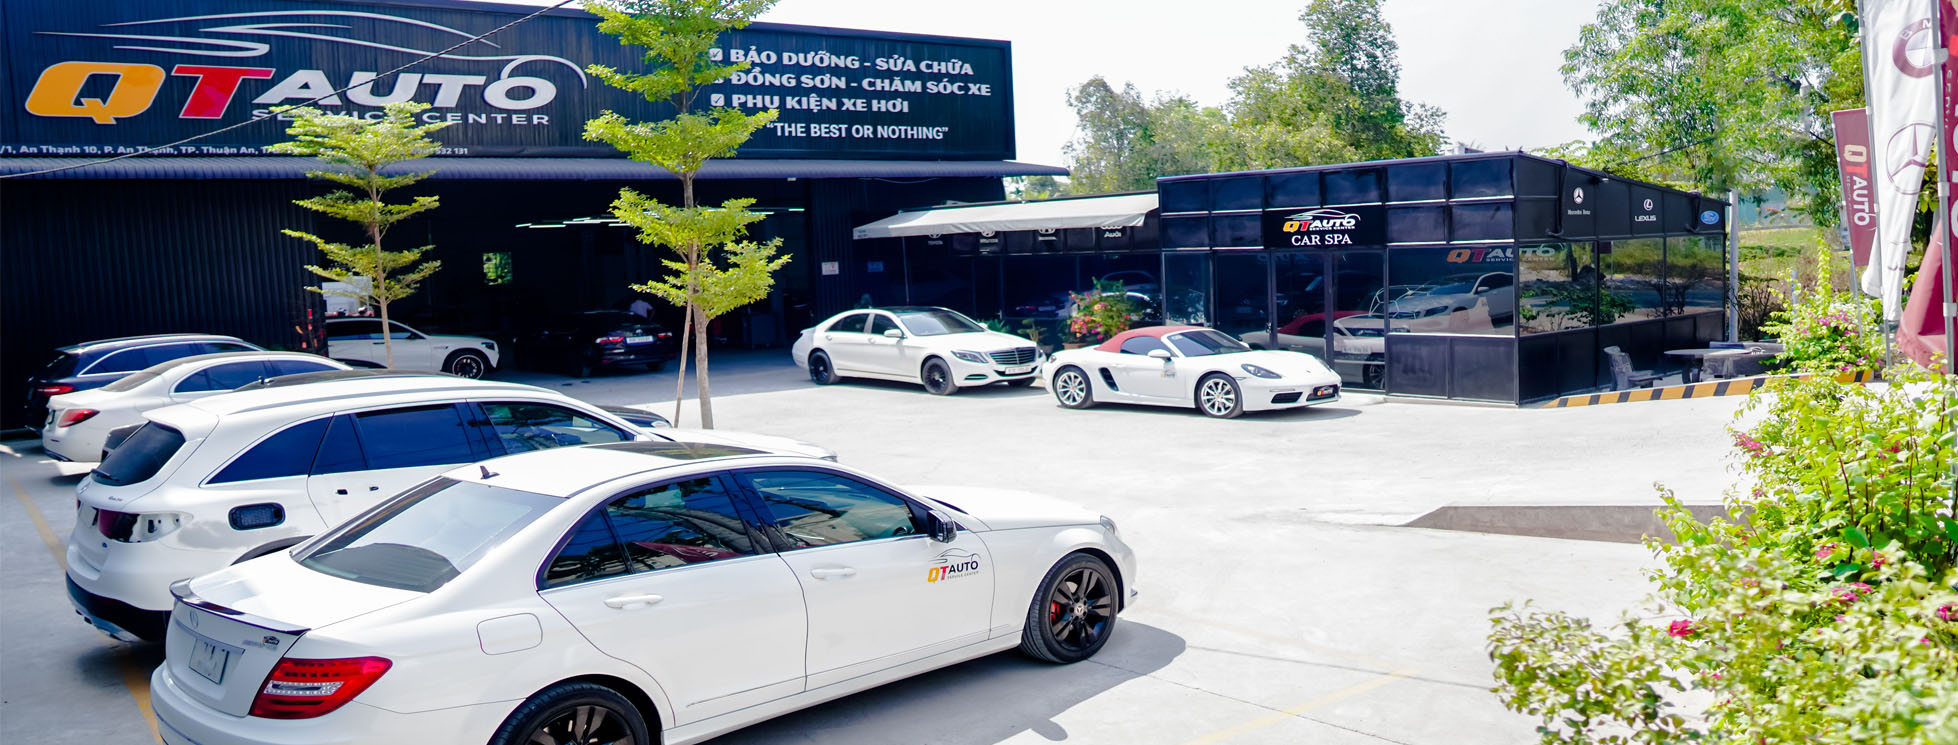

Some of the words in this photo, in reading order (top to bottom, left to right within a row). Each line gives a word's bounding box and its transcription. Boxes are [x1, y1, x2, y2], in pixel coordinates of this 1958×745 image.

[730, 46, 777, 64] BẢO
[782, 51, 860, 69] DƯỠNG
[875, 54, 917, 72] SỬA
[919, 58, 974, 75] CHỮA
[730, 67, 797, 87] ĐỒNG
[800, 73, 847, 89] SƠN
[861, 77, 922, 93] CHĂM
[926, 78, 965, 95] SÓC
[967, 83, 991, 96] XE
[785, 93, 837, 112] KIỆN
[841, 98, 868, 111] XE
[871, 98, 909, 113] HƠI
[422, 112, 549, 125] CENTER
[810, 123, 848, 138] BEST
[851, 124, 873, 138] OR
[20, 145, 38, 154] An
[40, 145, 81, 156] Thạnh
[83, 145, 102, 155] 10,
[104, 145, 114, 154] P.
[117, 145, 134, 154] An
[180, 146, 199, 154] TP.
[201, 145, 235, 156] Thuận
[240, 146, 259, 155] An,
[1291, 235, 1321, 246] CAR
[1325, 233, 1352, 245] SPA
